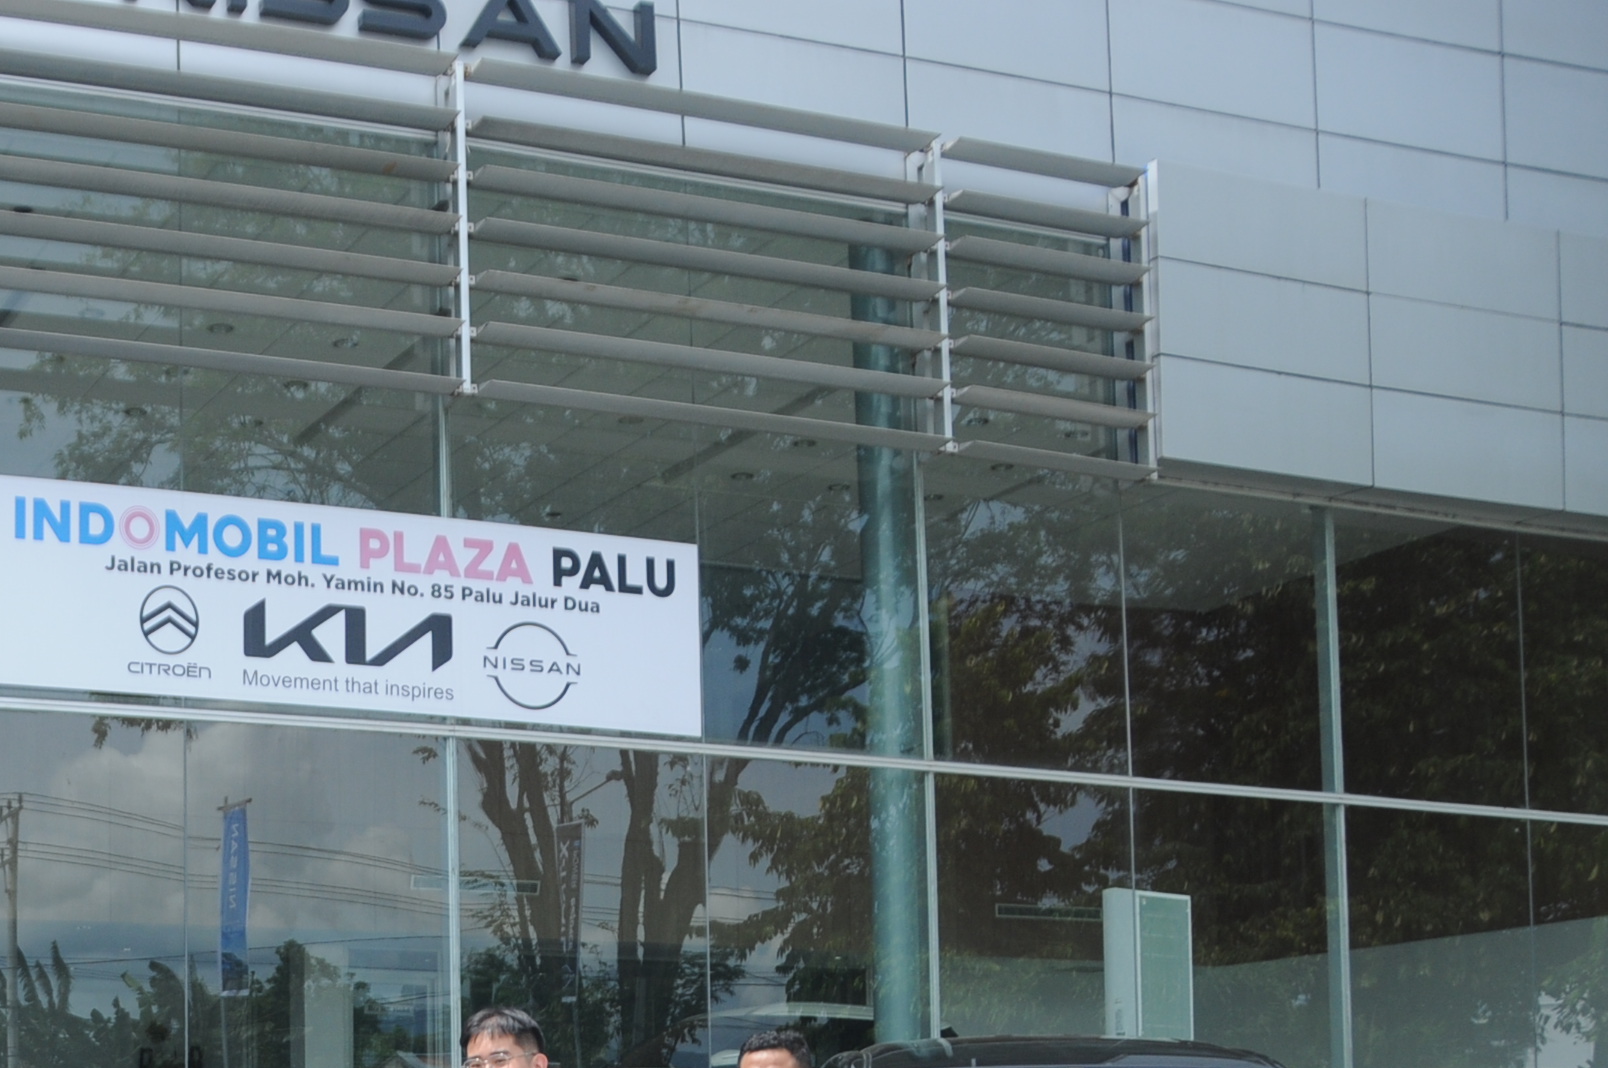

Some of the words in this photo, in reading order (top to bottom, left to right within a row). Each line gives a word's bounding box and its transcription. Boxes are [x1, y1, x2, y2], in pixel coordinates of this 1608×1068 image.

[127, 0, 657, 76] SAN
[14, 495, 340, 567] INDOMOBIL
[359, 527, 534, 585] PLAZA
[552, 546, 676, 598] PALU
[105, 555, 162, 576] Jalan
[169, 560, 259, 583] Profesor
[266, 568, 315, 588] Moh.
[322, 573, 384, 594] Yamin
[391, 579, 424, 598] No.
[430, 583, 455, 600] 85
[461, 586, 503, 605] Palu
[509, 591, 558, 609] Jalur
[564, 596, 600, 615] Dua
[243, 597, 453, 673] KIA
[127, 661, 212, 679] CITROËN
[242, 668, 339, 692] Movement
[345, 674, 379, 695] that
[384, 679, 455, 701] inspires
[483, 655, 581, 677] NISSAN
